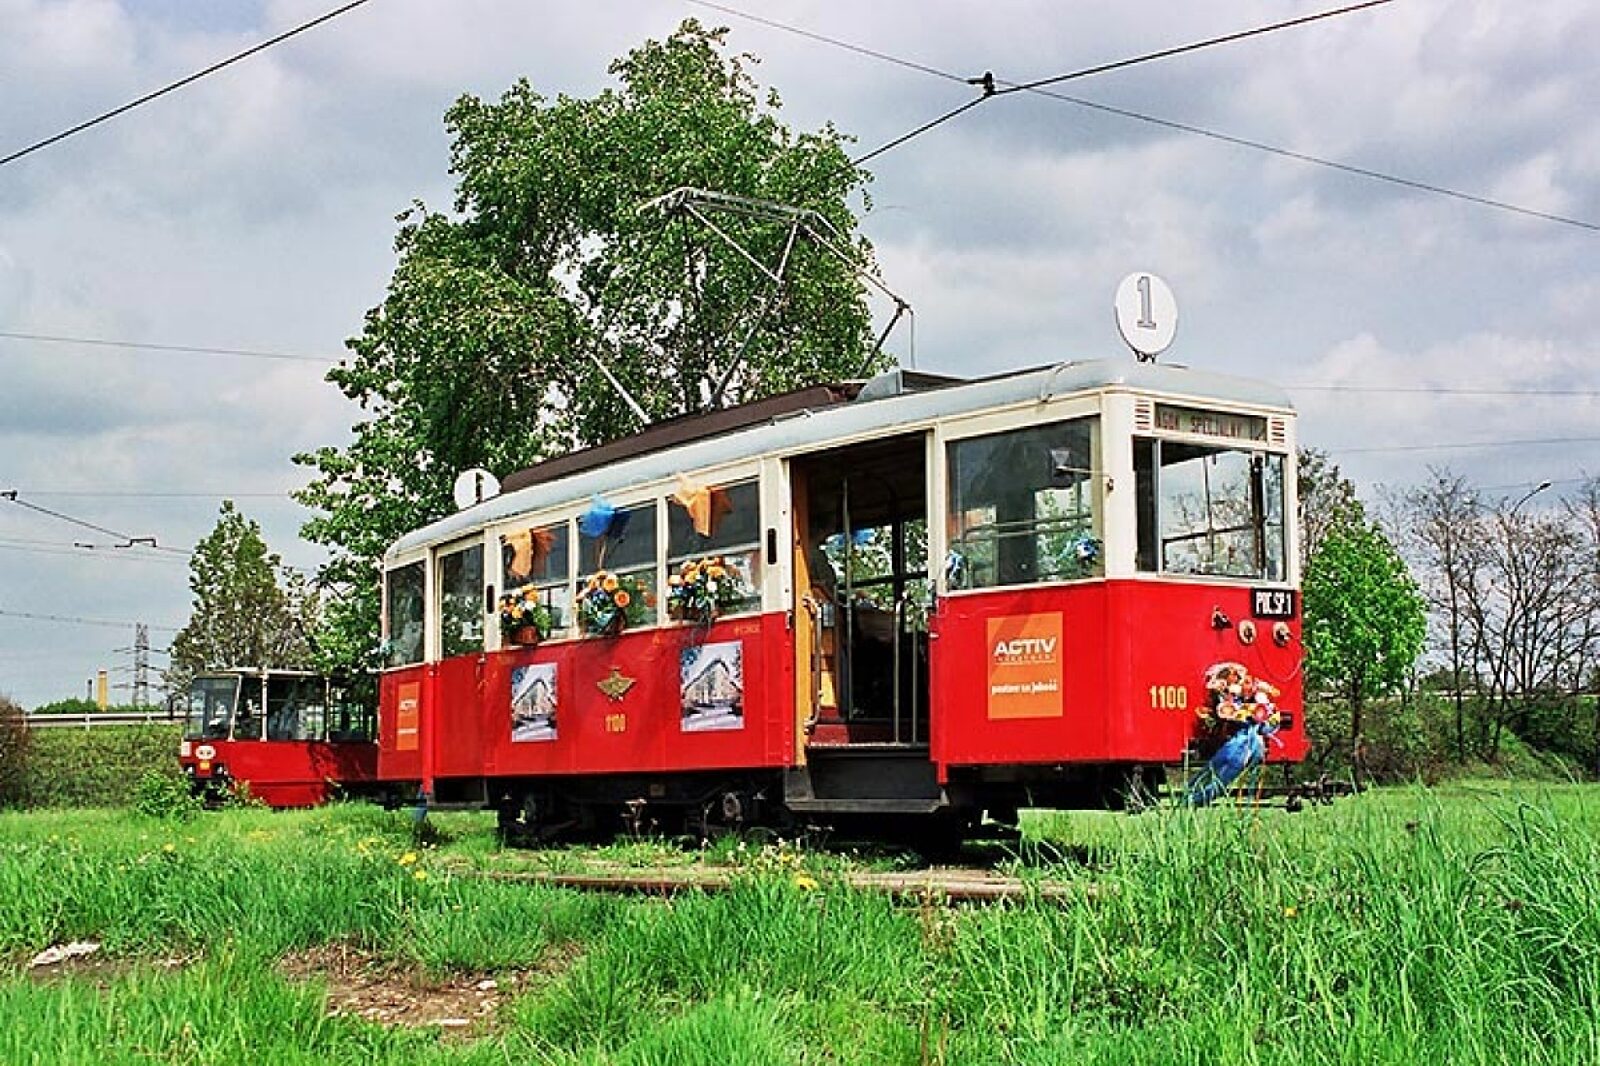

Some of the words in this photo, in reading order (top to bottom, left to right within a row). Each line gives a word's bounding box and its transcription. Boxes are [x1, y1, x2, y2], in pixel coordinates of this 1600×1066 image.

[1136, 275, 1156, 330] 1
[993, 637, 1057, 656] ACTIV
[1149, 685, 1187, 710] 1100
